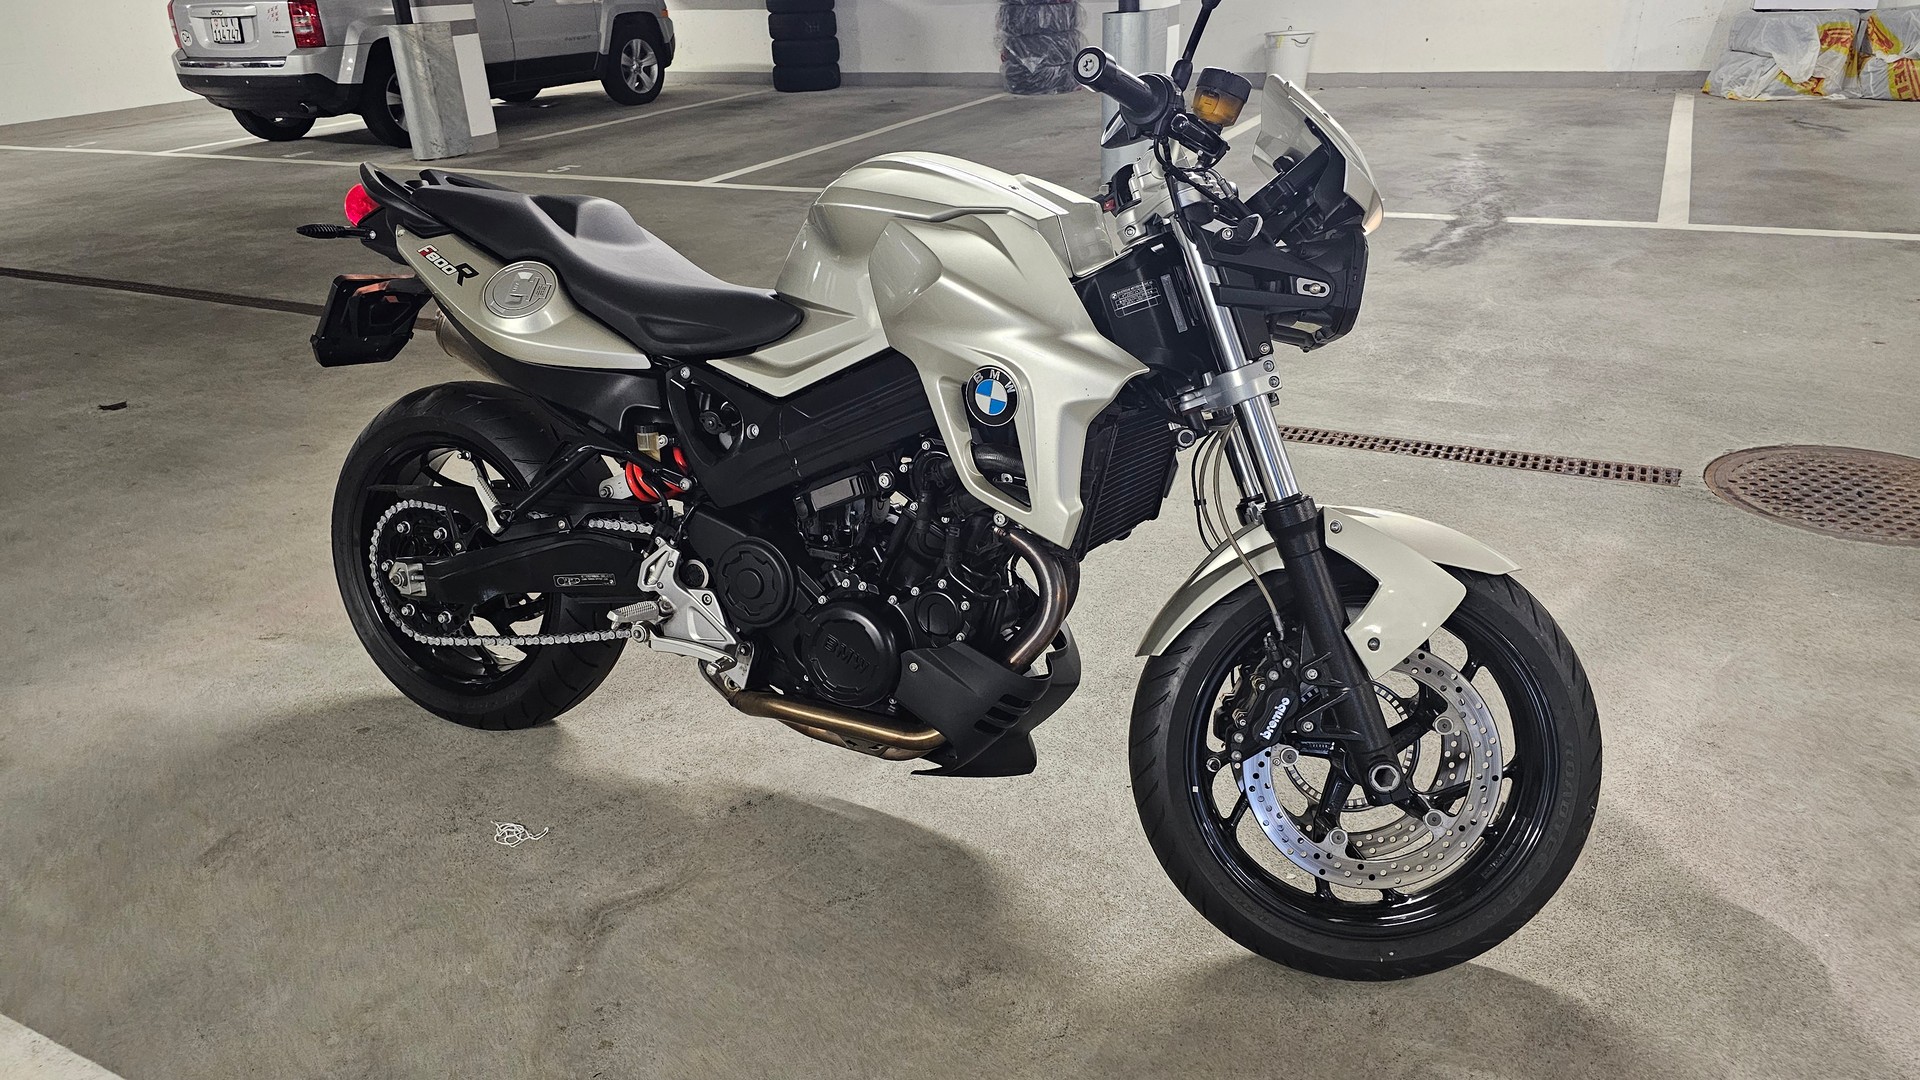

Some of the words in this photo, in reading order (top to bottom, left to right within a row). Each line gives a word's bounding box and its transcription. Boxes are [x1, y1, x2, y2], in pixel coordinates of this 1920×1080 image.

[214, 29, 239, 41] 114747
[416, 244, 480, 287] F800R
[973, 369, 1016, 394] BMW
[824, 634, 871, 674] BMW
[1259, 697, 1291, 740] brembo
